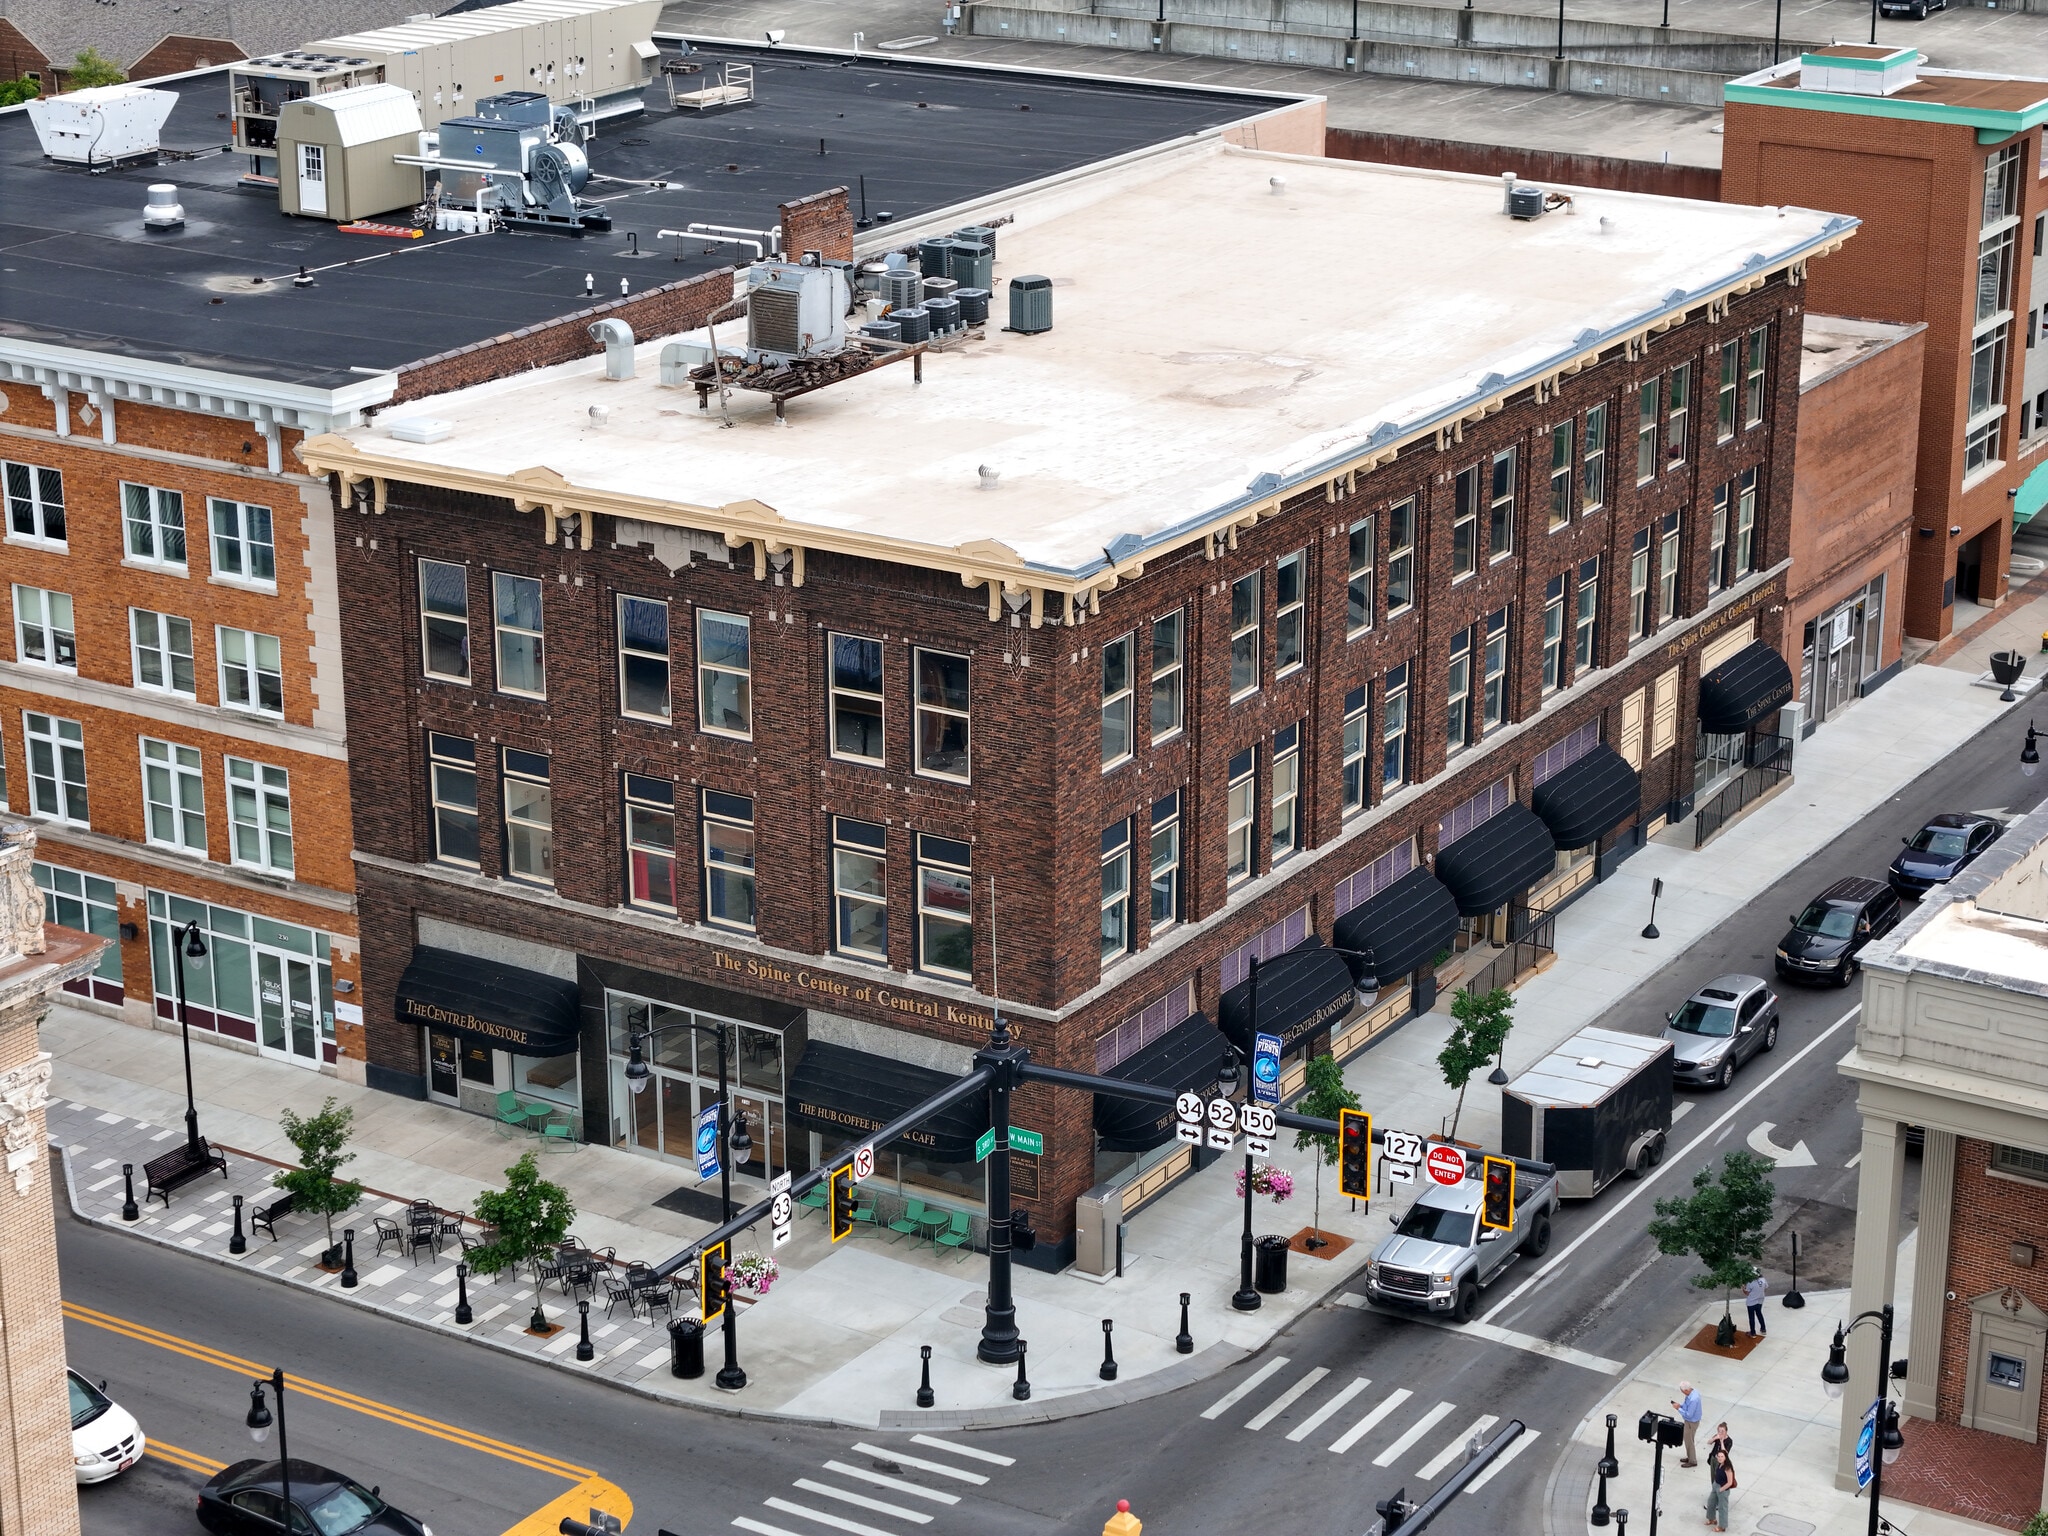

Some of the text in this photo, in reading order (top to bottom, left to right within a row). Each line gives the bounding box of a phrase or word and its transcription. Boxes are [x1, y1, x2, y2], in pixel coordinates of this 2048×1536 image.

[1720, 611, 1728, 625] of
[278, 933, 289, 941] 230
[712, 951, 1024, 1040] The Spine Center of Central Kentuky
[1257, 1041, 1279, 1057] FIRSTS
[1179, 1098, 1202, 1118] 34
[1211, 1104, 1233, 1124] 52
[799, 1102, 816, 1116] THE
[817, 1107, 837, 1121] HUB
[838, 1112, 870, 1130] COFFEE
[912, 1131, 936, 1146] CAFE
[1243, 1110, 1274, 1131] 150
[981, 1140, 991, 1151] 3RD
[1017, 1135, 1035, 1147] MAIN
[1386, 1136, 1419, 1157] 127
[1433, 1151, 1460, 1164] DO NOT
[1434, 1168, 1457, 1180] ENTER
[772, 1177, 791, 1193] NORTH
[773, 1197, 791, 1221] 33
